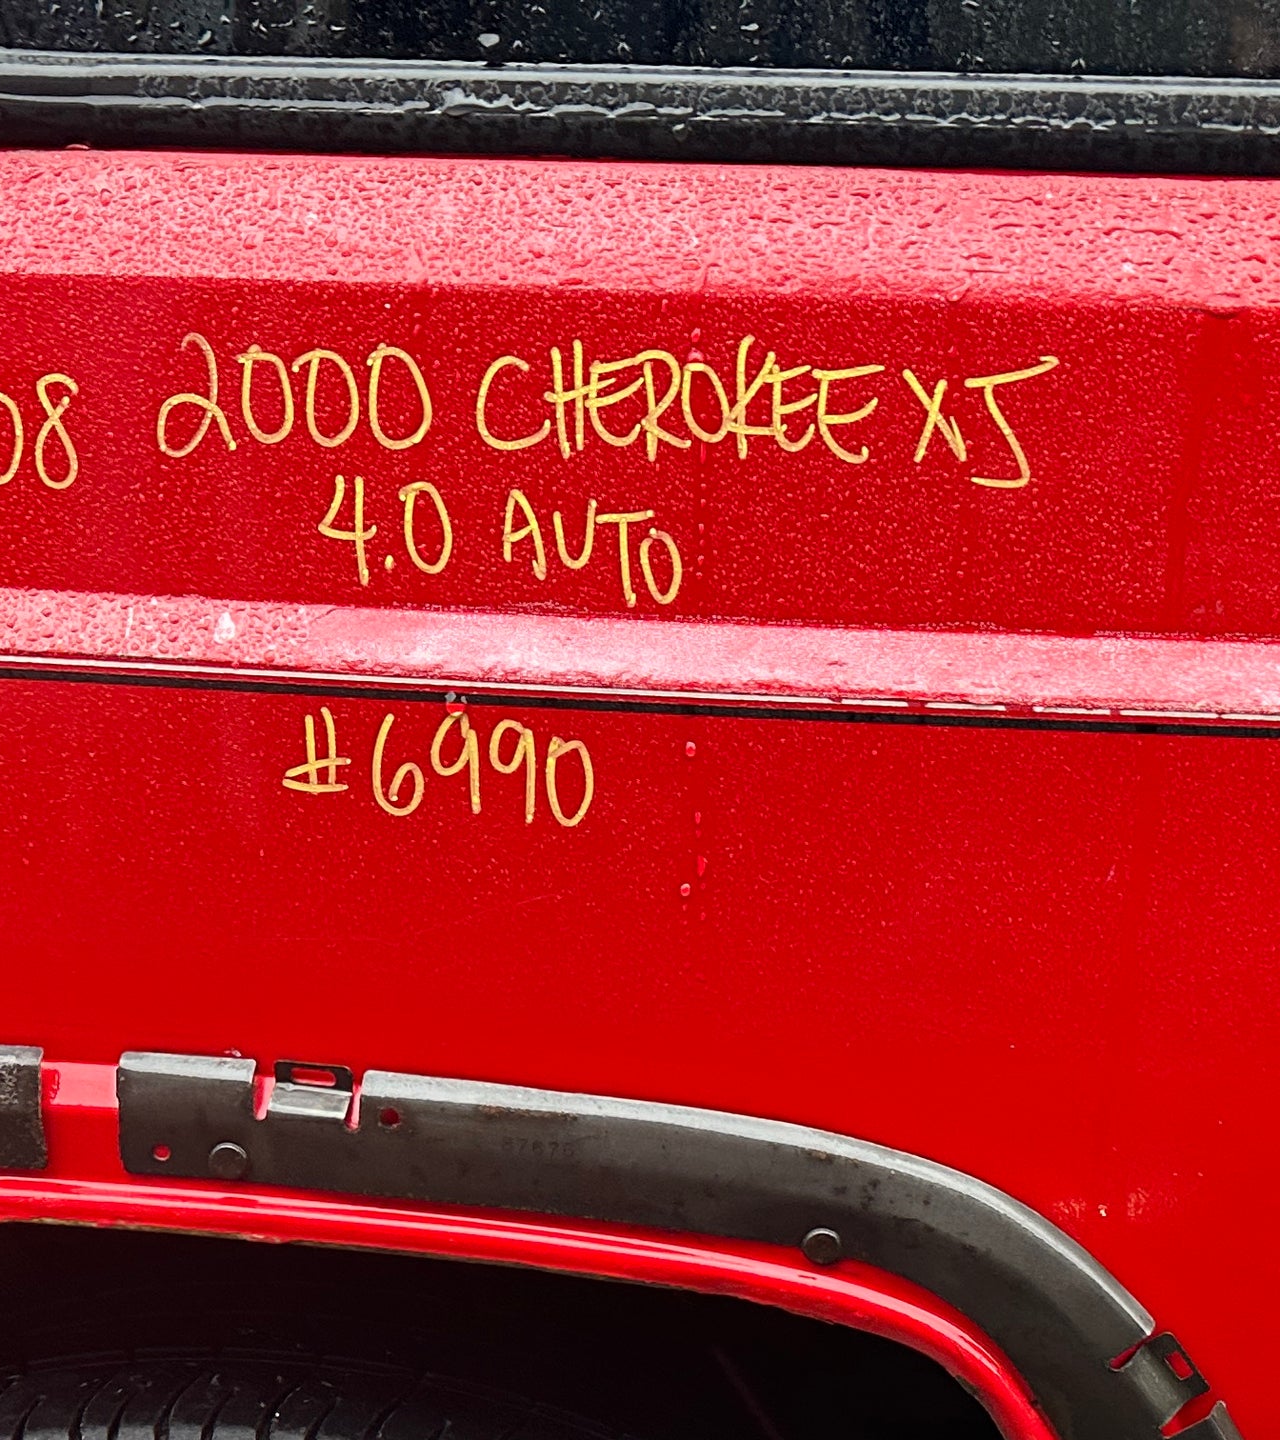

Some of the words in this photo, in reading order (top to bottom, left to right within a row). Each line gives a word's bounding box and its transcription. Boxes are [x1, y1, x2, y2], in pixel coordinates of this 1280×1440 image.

[157, 331, 433, 458] 2000
[475, 333, 885, 460] CHEROKEE
[901, 354, 1059, 490] XJ
[317, 474, 453, 586] 4.0
[502, 487, 684, 607] AUTO
[281, 706, 596, 828] #6990
